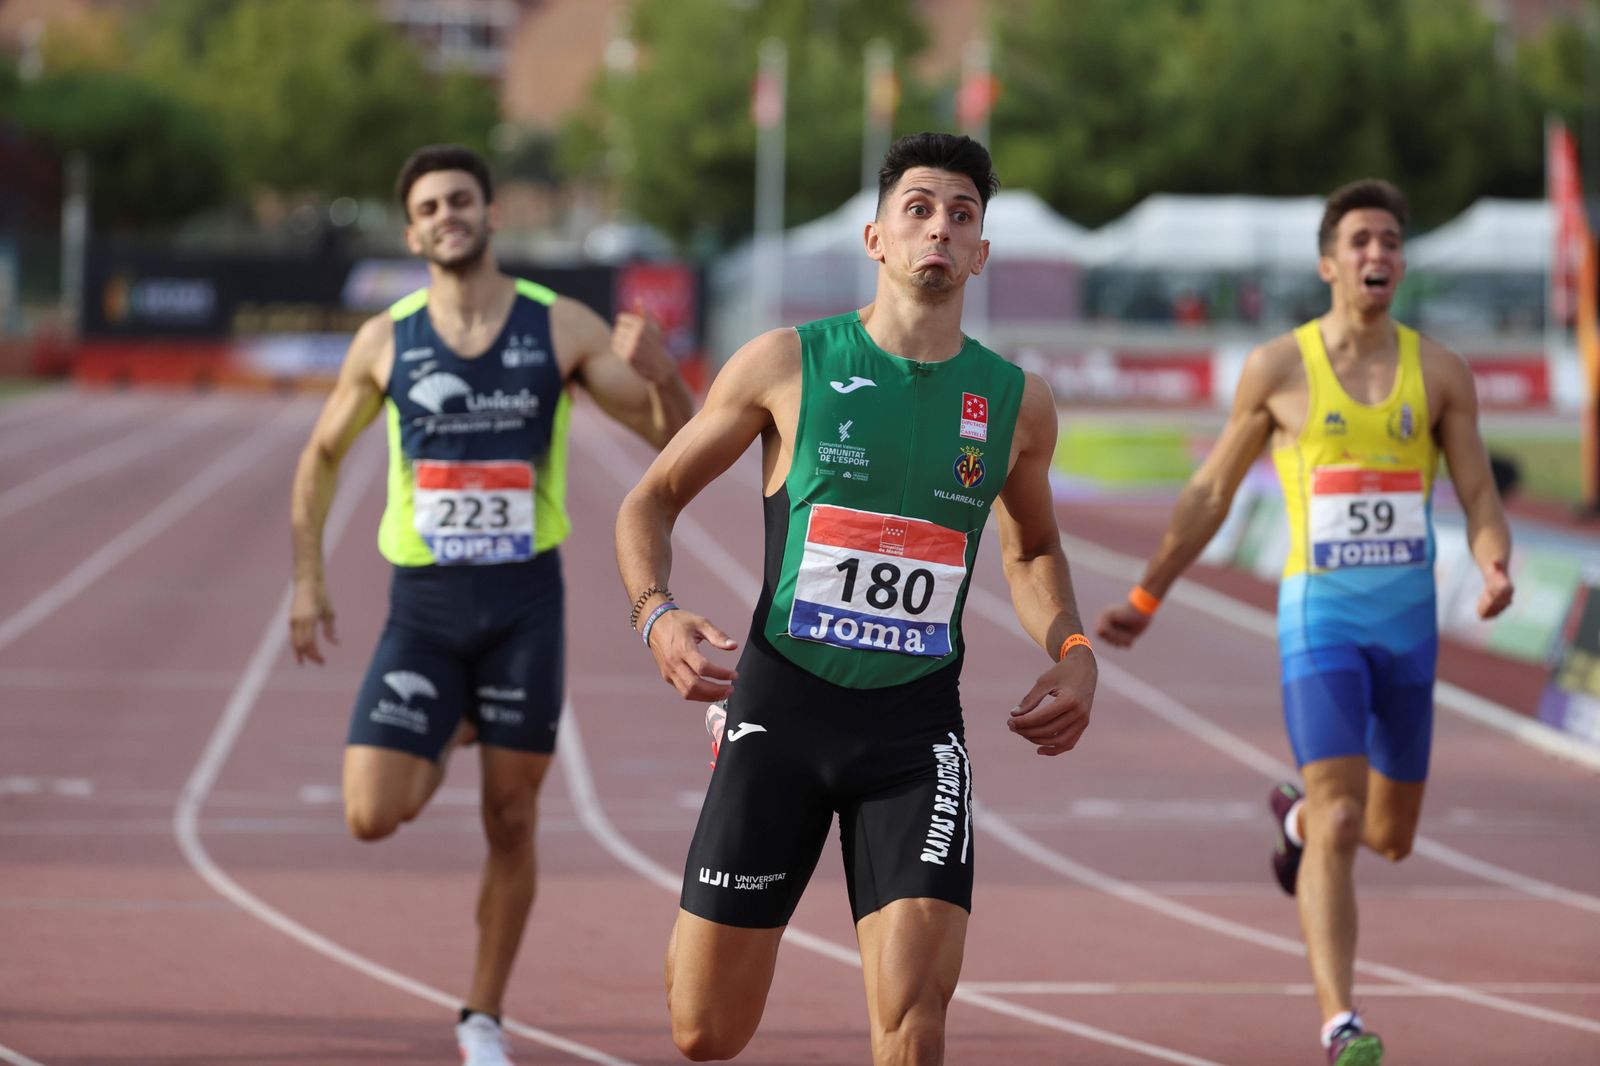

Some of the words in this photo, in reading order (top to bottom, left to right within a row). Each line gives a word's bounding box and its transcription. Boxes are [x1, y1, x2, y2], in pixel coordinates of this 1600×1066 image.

[818, 447, 865, 458] COMUNITAT
[820, 454, 831, 462] DE
[832, 455, 870, 467] L'ESPORT
[934, 489, 976, 506] VILLARREAL
[437, 496, 510, 530] 223
[1348, 499, 1395, 535] 59
[1326, 541, 1412, 568] Joma
[836, 557, 935, 616] 180
[810, 612, 926, 653] Joma
[933, 794, 959, 816] DE
[920, 814, 956, 866] PLAYAS
[734, 882, 764, 890] JAUME
[735, 872, 787, 883] UNIVERSITAT
